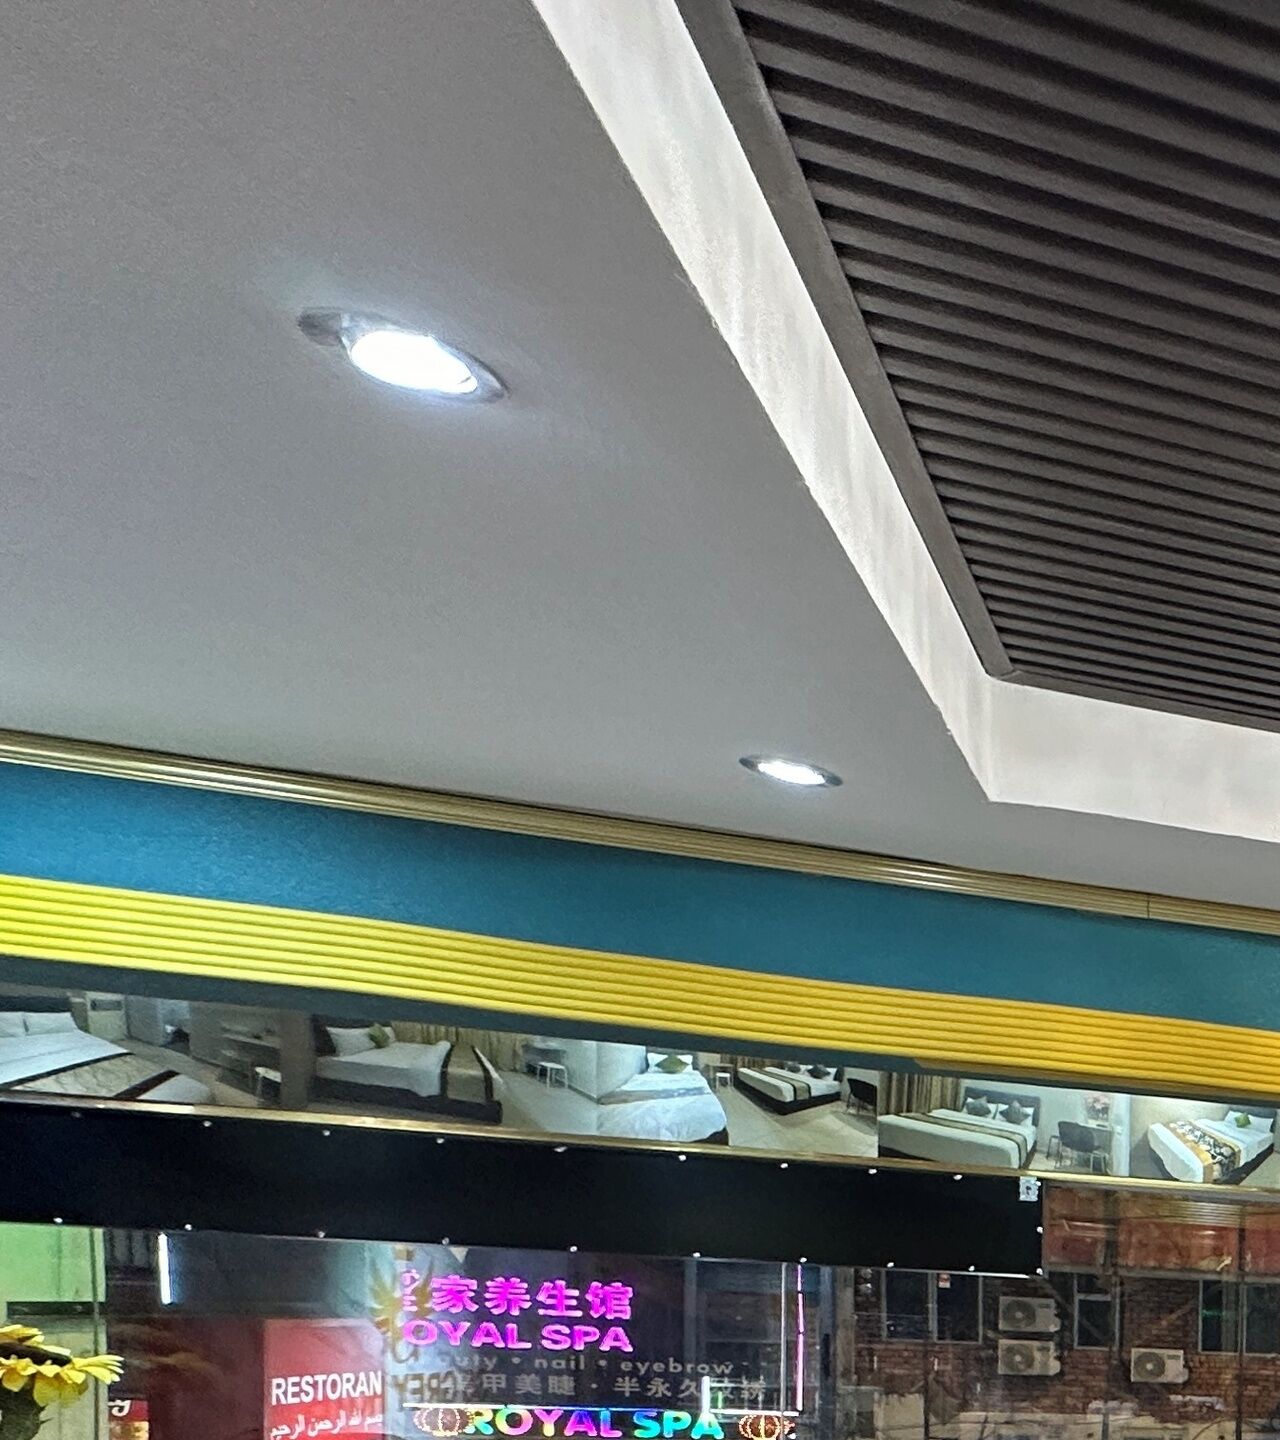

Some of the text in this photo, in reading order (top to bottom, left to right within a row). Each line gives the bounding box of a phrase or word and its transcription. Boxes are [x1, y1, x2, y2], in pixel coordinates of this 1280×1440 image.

[402, 1320, 634, 1353] OYAL SPA
[534, 1356, 585, 1370] nail
[620, 1358, 734, 1376] eyebrow
[271, 1371, 382, 1406] RESTORAN
[467, 1405, 725, 1440] ROYAL SPA
